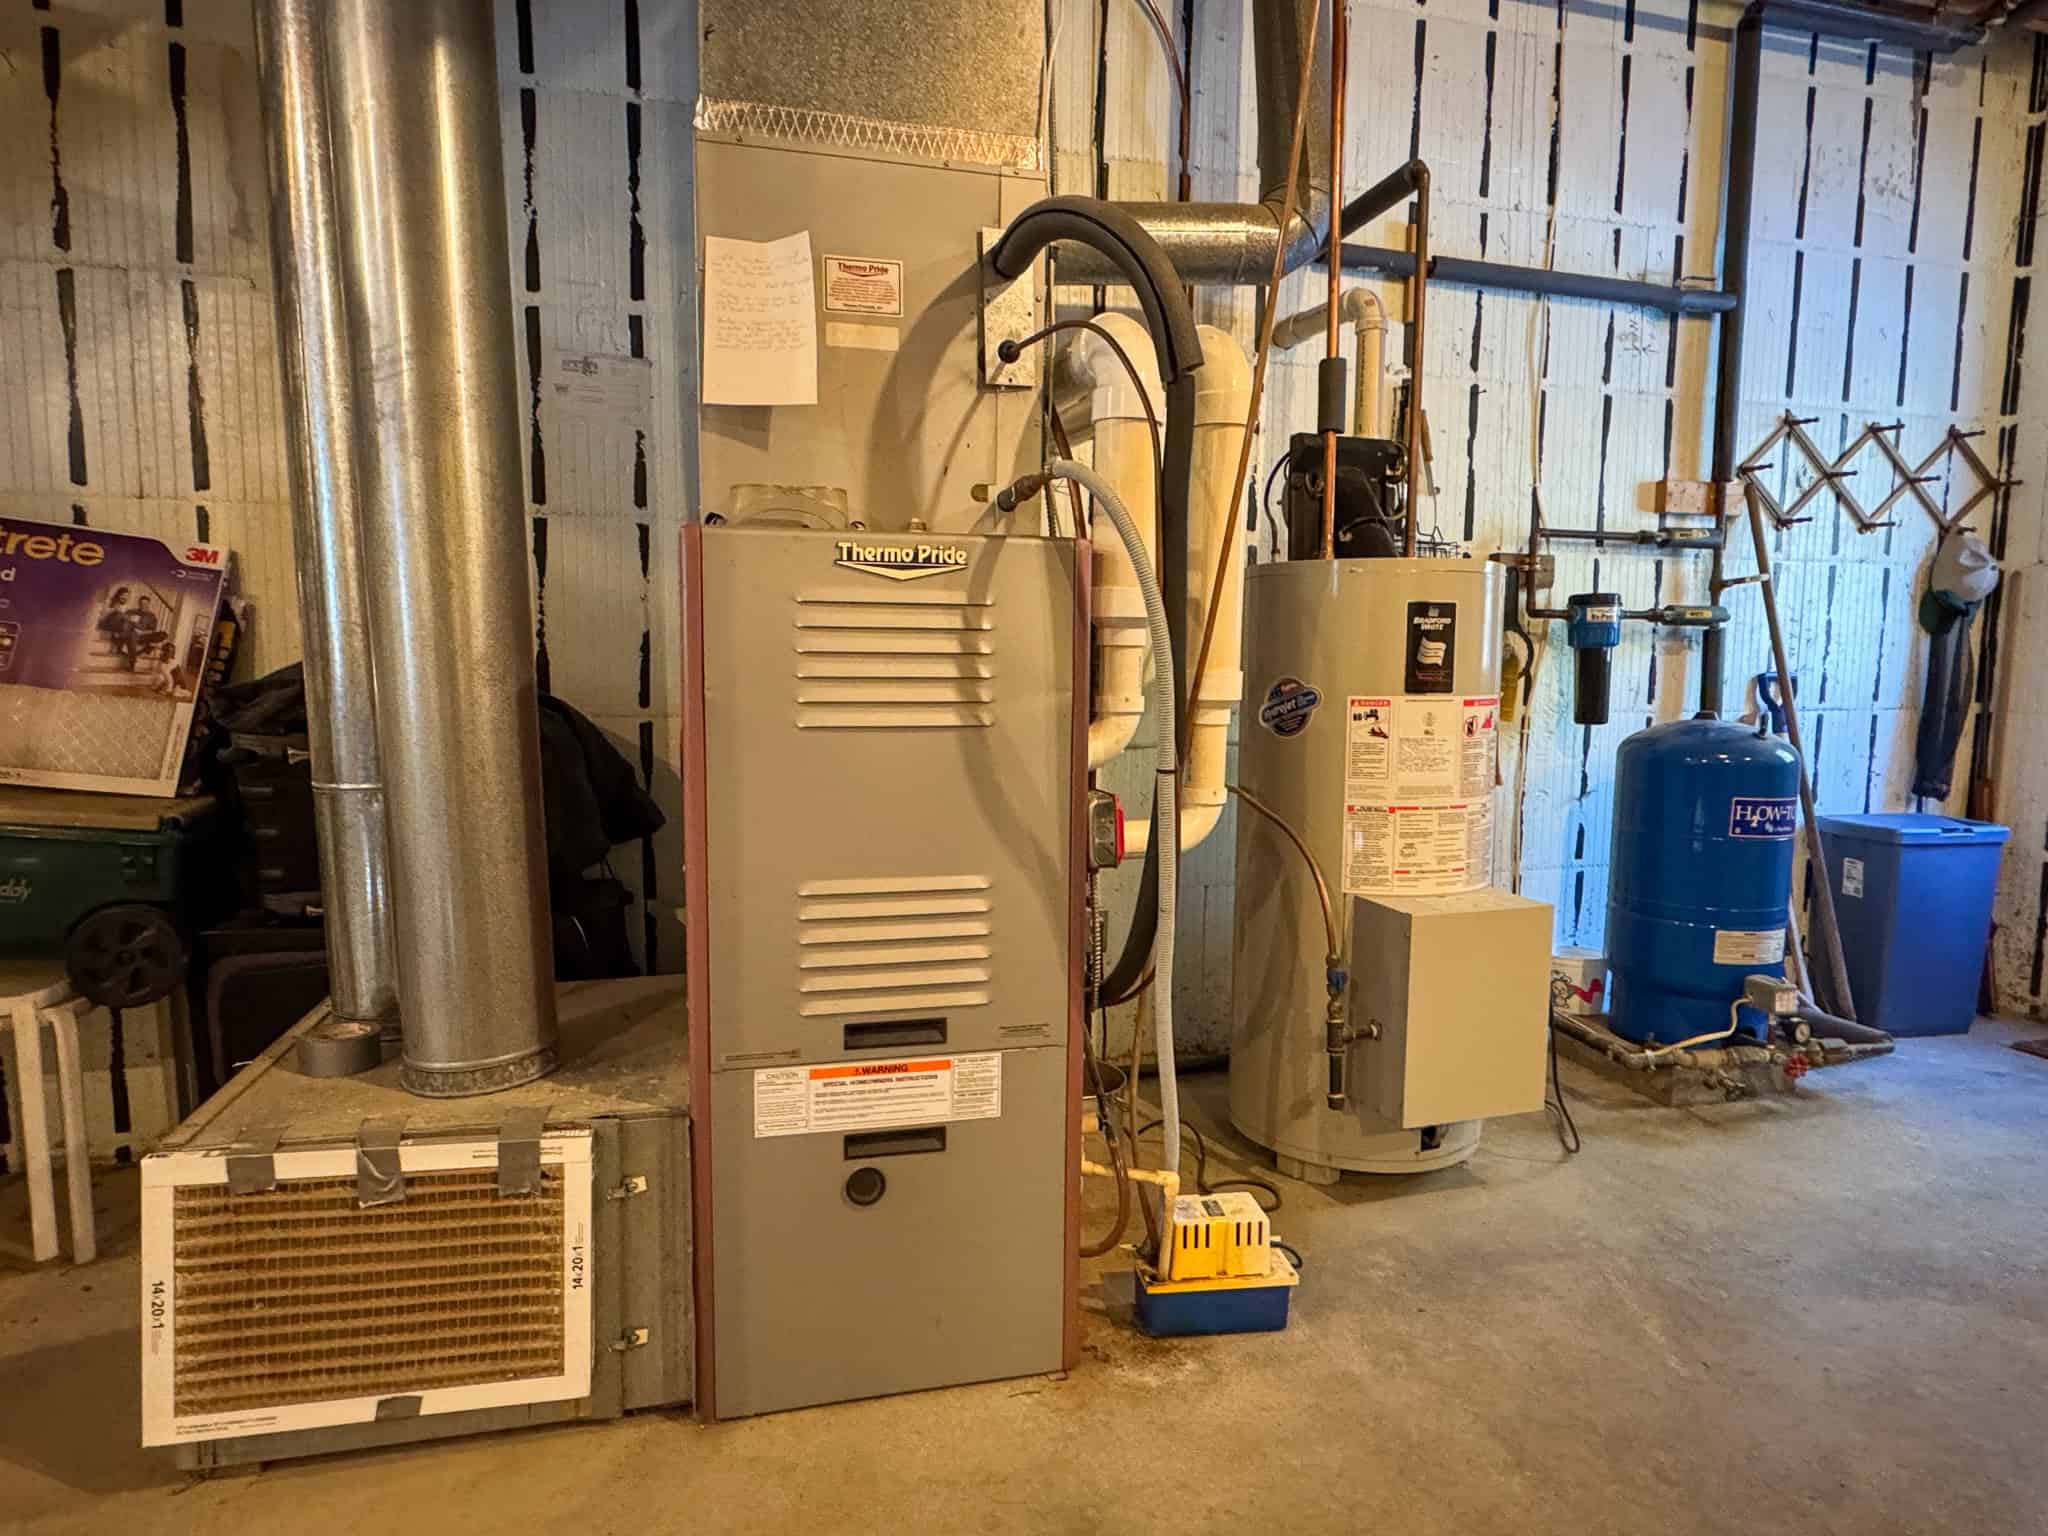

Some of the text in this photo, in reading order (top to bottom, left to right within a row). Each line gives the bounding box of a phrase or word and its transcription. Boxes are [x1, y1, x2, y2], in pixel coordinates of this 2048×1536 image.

[186, 548, 219, 564] 3M
[838, 542, 967, 564] Thermo Pride
[861, 1063, 909, 1075] WARNING
